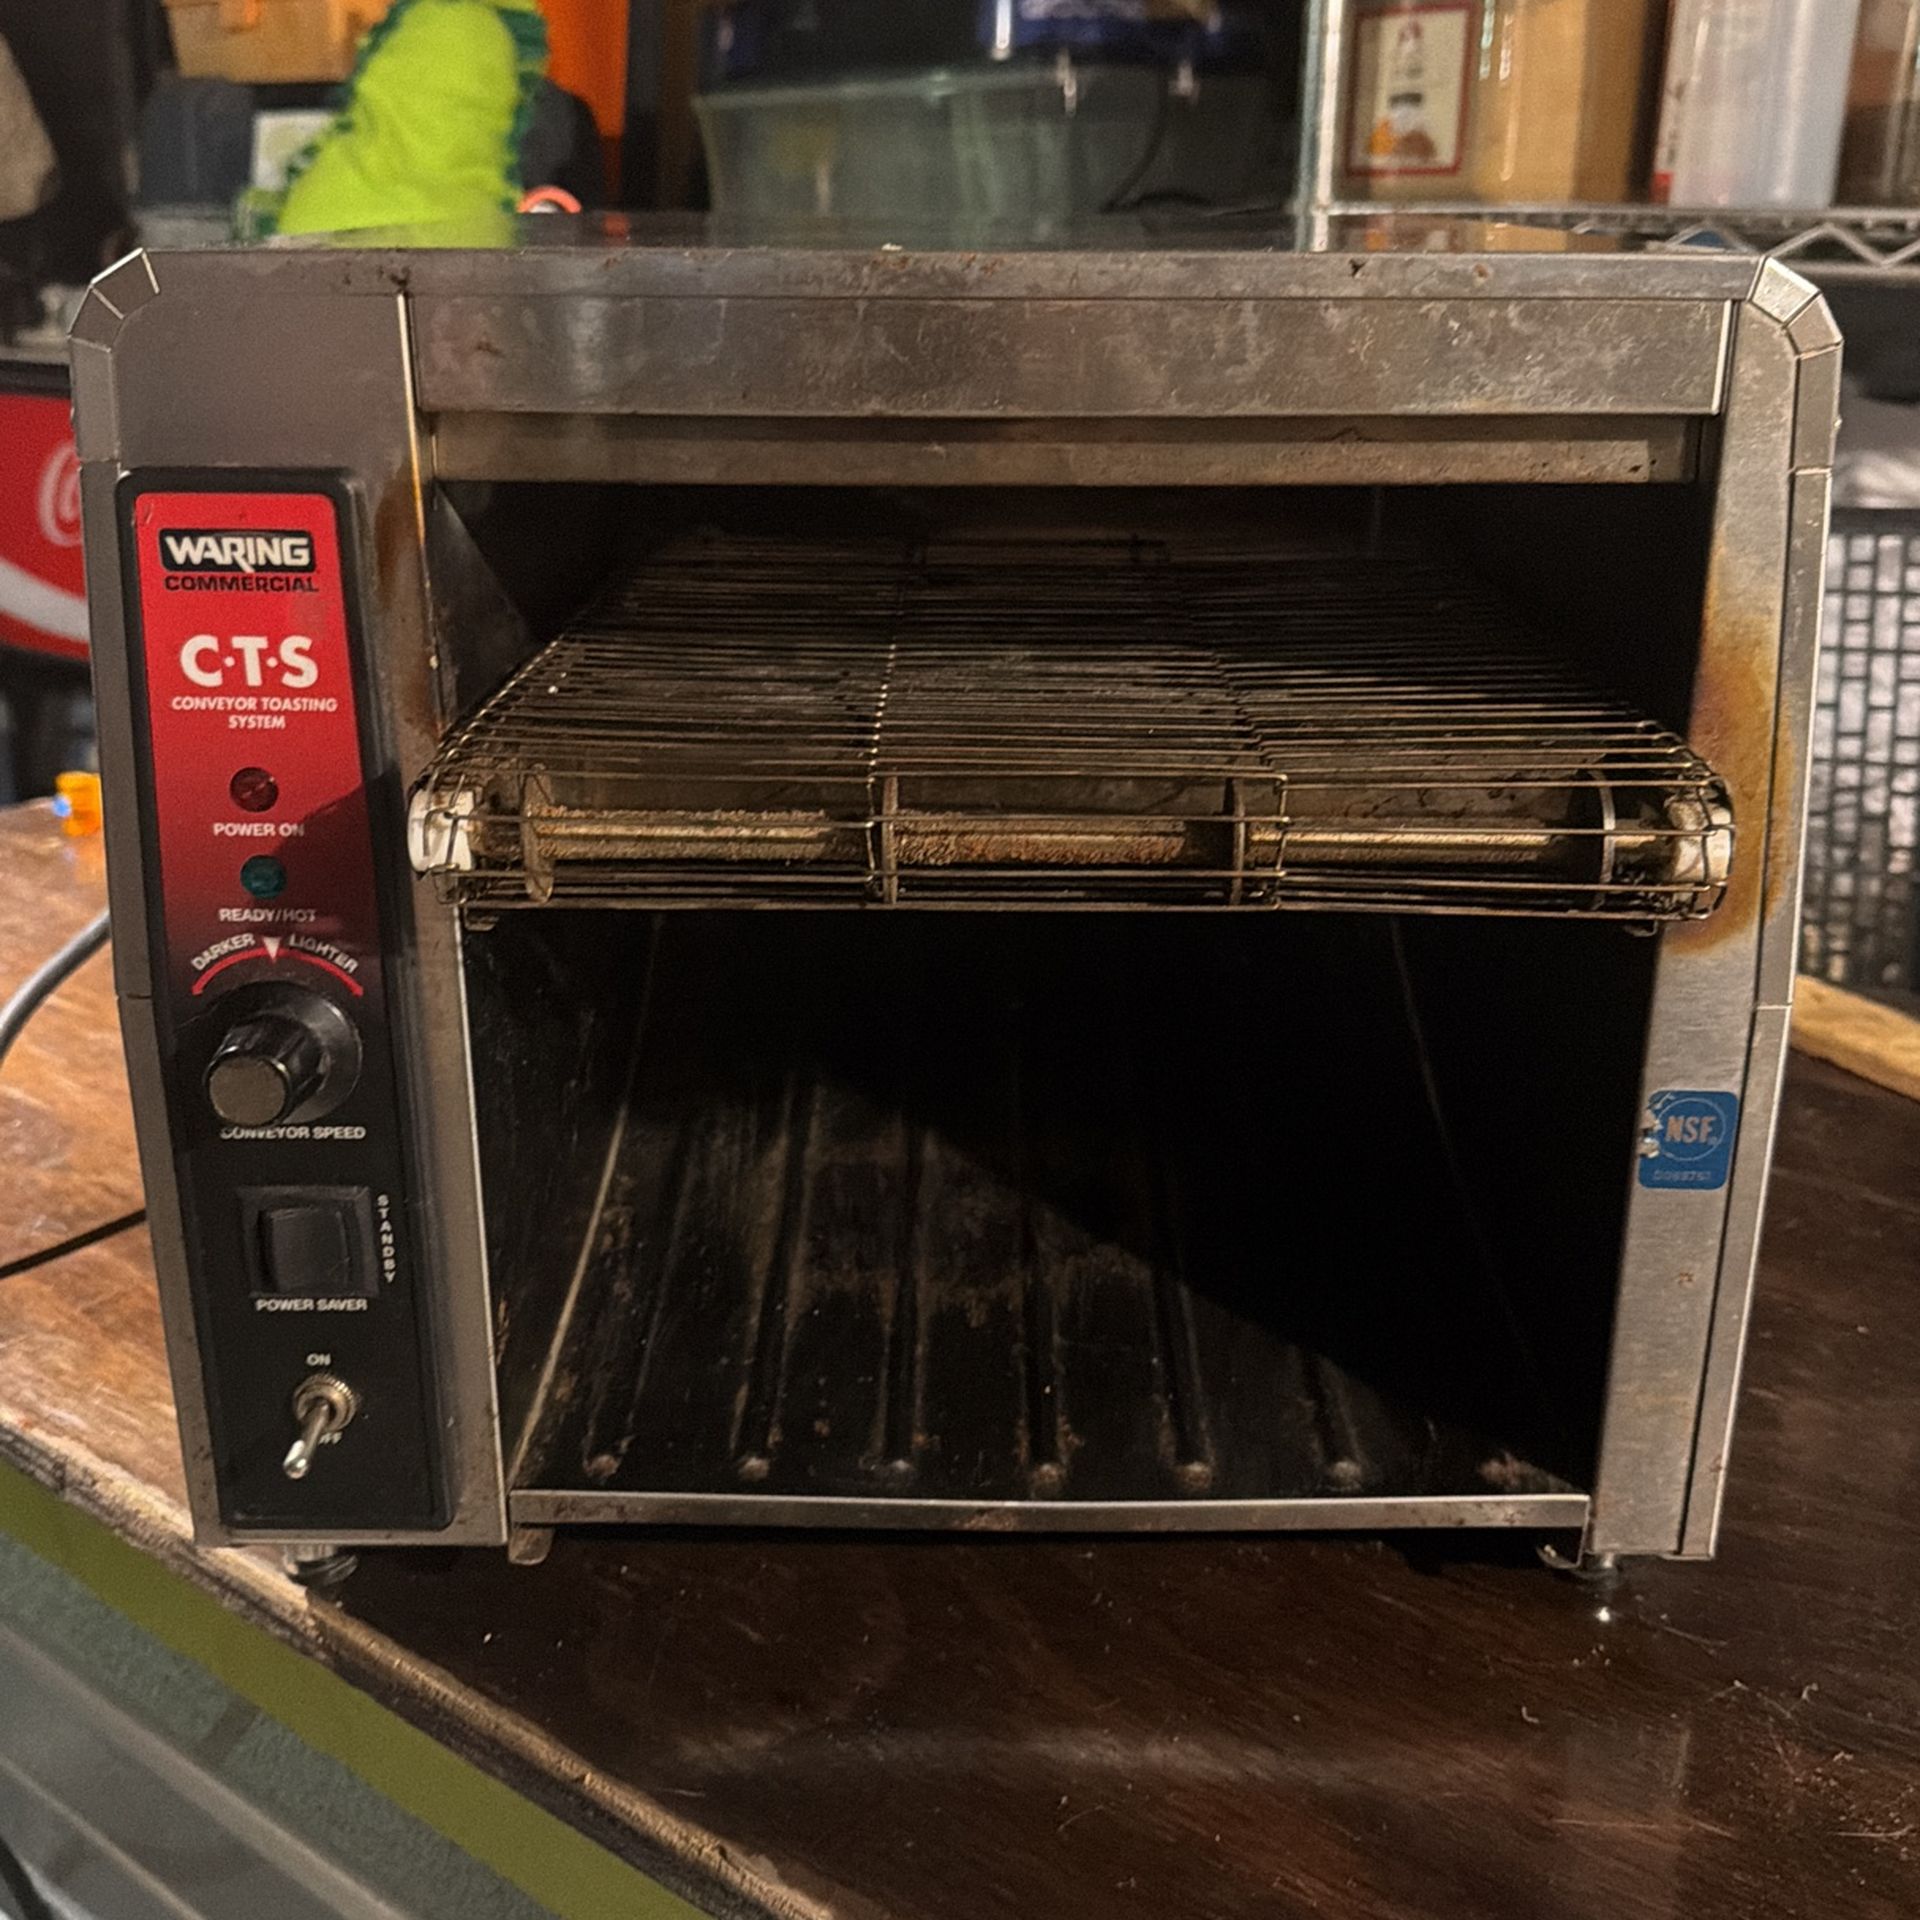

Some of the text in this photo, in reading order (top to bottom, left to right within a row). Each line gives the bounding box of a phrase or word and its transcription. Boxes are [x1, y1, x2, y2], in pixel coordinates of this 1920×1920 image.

[164, 535, 310, 573] WARING
[164, 576, 319, 592] COMMERCIAL
[171, 696, 338, 712] CONVEYOR TOASTING
[228, 715, 286, 729] SYSTEM
[213, 822, 305, 837] POWER ON
[218, 908, 317, 922] READY/HOT
[191, 933, 256, 971] DARKER
[289, 934, 360, 973] LIGHTER
[312, 1126, 367, 1139] SPEED
[377, 1194, 397, 1283] STANDBY
[256, 1298, 368, 1311] POWER SAVER
[306, 1352, 331, 1366] ON
